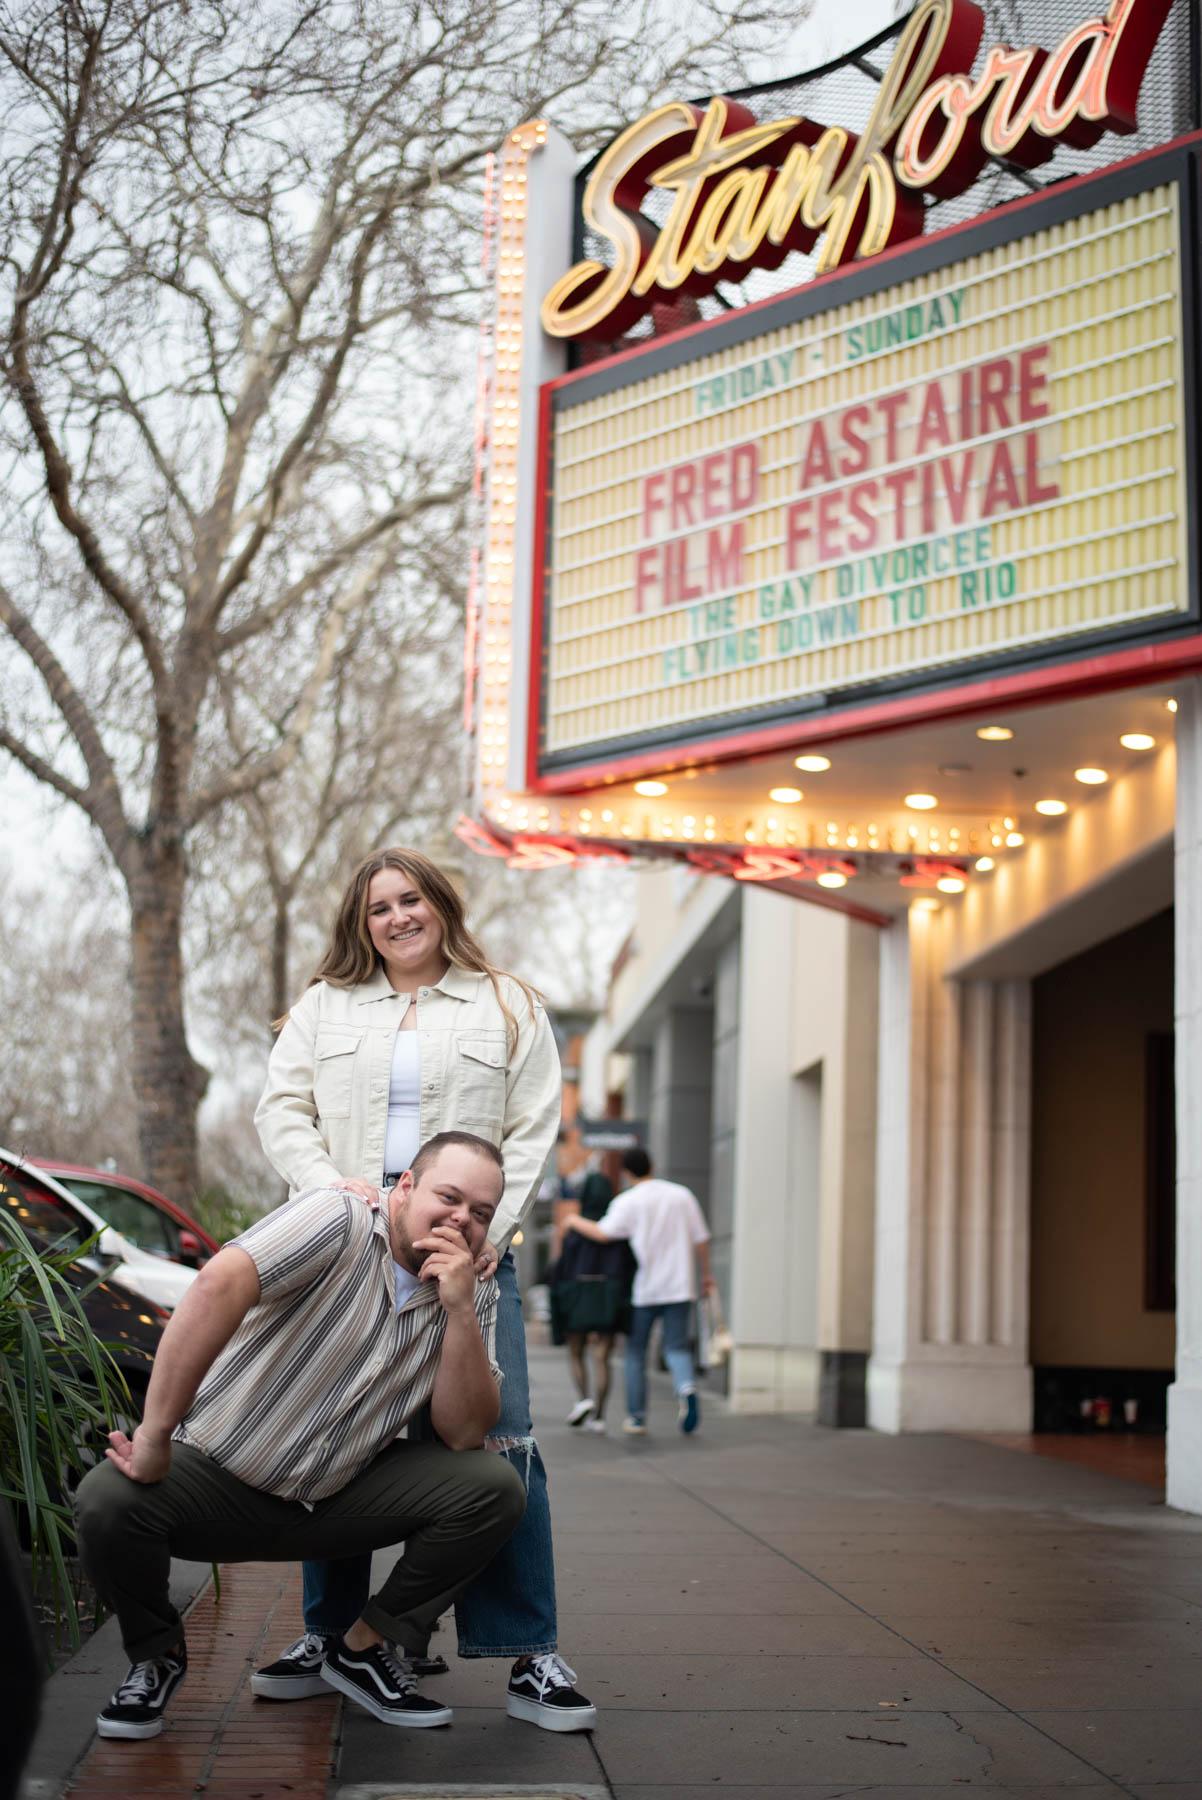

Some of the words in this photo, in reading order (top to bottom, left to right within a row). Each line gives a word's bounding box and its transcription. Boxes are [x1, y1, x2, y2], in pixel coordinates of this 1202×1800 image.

[541, 0, 1137, 337] Stanford
[697, 349, 795, 417] FRIDAY
[846, 287, 967, 362] SUNDAY
[643, 440, 761, 541] FRED
[801, 345, 1052, 493] ASTAIRE
[635, 522, 746, 614] FILM
[786, 432, 1060, 572] FESTIVAL
[690, 595, 736, 641] THE
[760, 572, 816, 620] GAY
[837, 525, 993, 599] DIVORCEE
[663, 630, 760, 683] FLYING
[778, 600, 861, 657] DOWN
[889, 585, 926, 628] TO
[960, 560, 1017, 609] RIO
